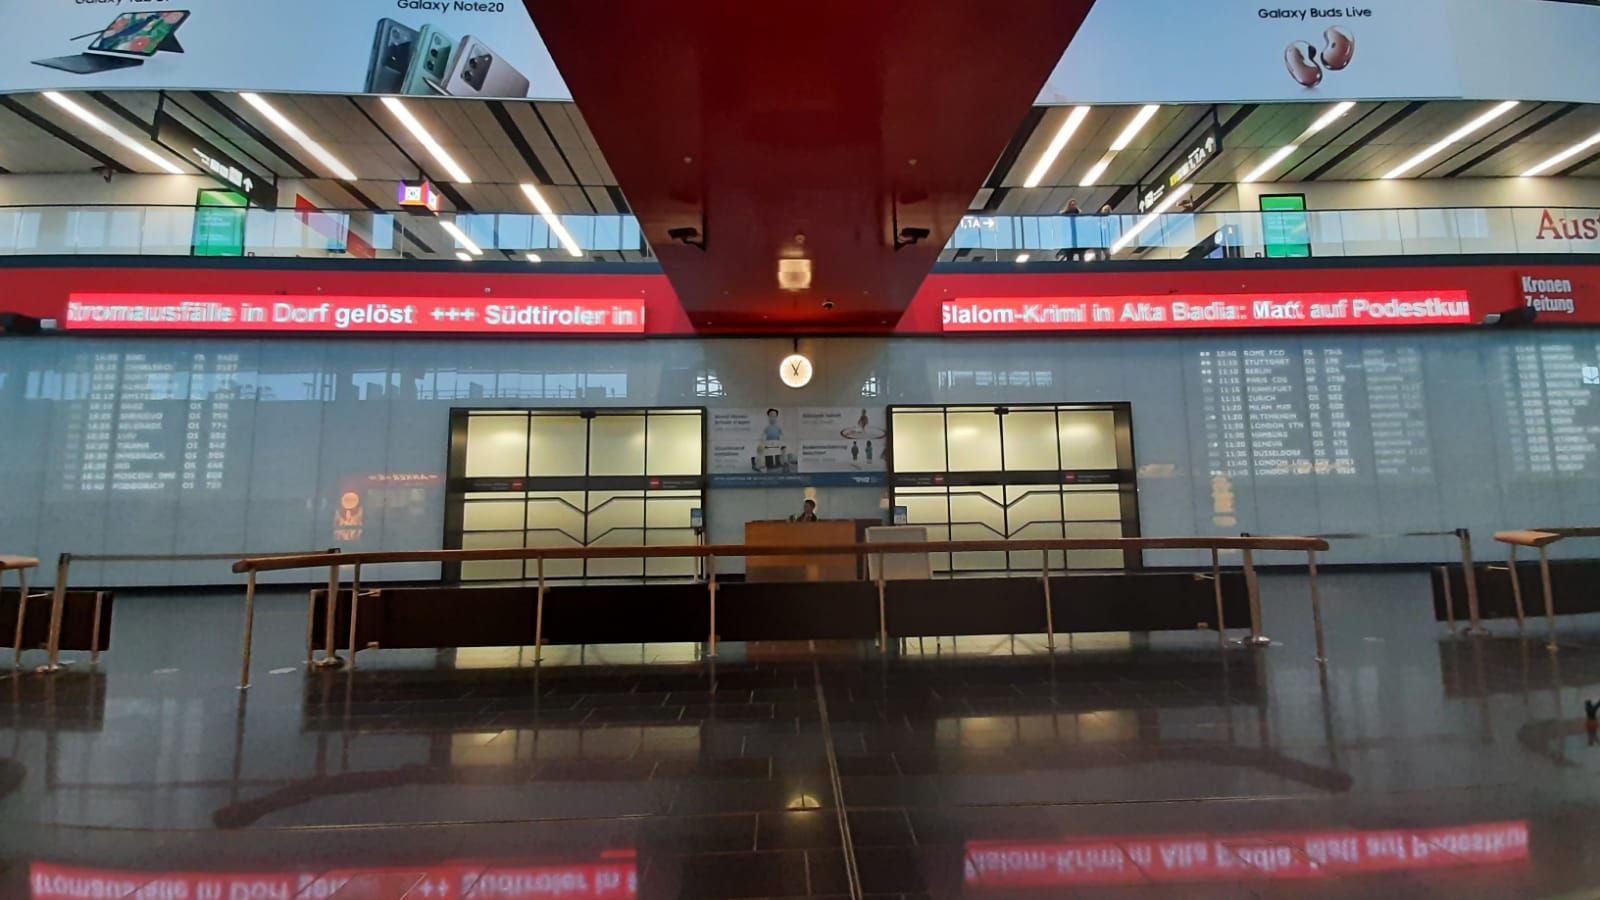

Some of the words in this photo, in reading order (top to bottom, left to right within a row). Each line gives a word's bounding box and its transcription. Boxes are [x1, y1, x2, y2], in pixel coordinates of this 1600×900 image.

[397, 0, 449, 13] Galaxy
[454, 1, 505, 13] Note20
[1258, 8, 1306, 21] Galaxy
[1310, 7, 1342, 18] Buds
[1346, 6, 1372, 17] Live
[1522, 275, 1571, 293] Kronen
[943, 302, 1086, 323] Slalom-Krimi
[1093, 303, 1114, 322] in
[1120, 302, 1168, 321] Alta
[1310, 299, 1348, 319] auf
[1525, 294, 1574, 313] Zeitung
[241, 302, 264, 322] in
[272, 302, 329, 322] Dorf
[335, 304, 413, 328] gelöst
[484, 304, 610, 325] Südtiroler
[612, 305, 635, 325] in
